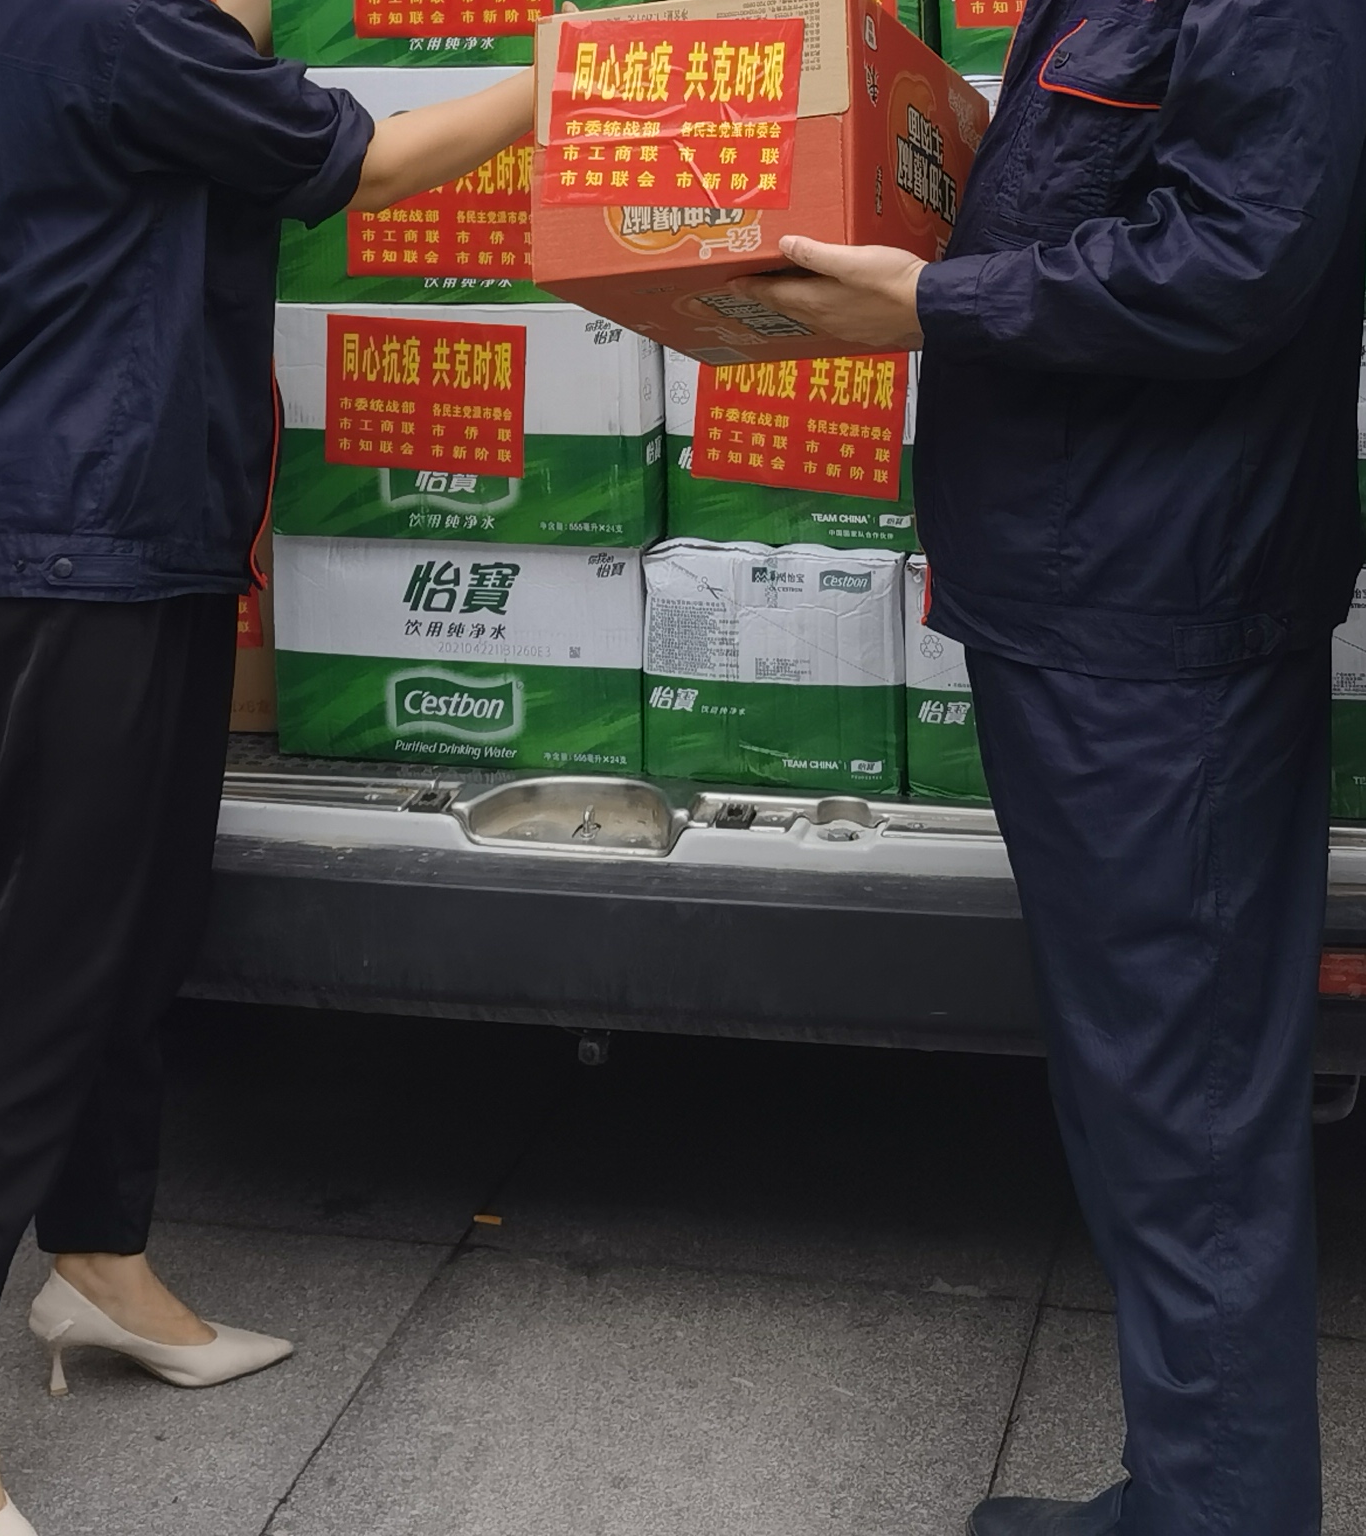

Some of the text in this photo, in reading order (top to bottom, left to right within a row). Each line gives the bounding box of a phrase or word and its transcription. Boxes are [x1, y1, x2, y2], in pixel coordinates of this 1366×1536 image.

[368, 9, 543, 25] 市知联会 市新阶联
[409, 37, 495, 51] 饮用纯净水
[571, 40, 786, 104] 同心抗疫 共克时艰
[565, 119, 781, 140] 市委统战部 各民主党派市委会
[562, 143, 779, 165] 市工商联 市侨联
[559, 170, 777, 190] 市知联会 市新阶联
[362, 208, 439, 222] 市委统战部
[362, 229, 439, 243] 市工商联
[701, 226, 761, 252] 统一
[362, 249, 438, 263] 市知联会
[343, 333, 511, 389] 同心抗疫 共克时艰
[809, 356, 895, 408] 共克时艰
[341, 398, 511, 420] 市委统战部 各民主党派市委会
[341, 418, 511, 441] 市工商联 市侨联
[711, 406, 890, 440] 市委统战部 各民主党派市委会
[340, 439, 511, 461] 市知联会 市新阶联
[709, 427, 889, 461] 市工商联 市侨联
[707, 448, 886, 482] 市知联会 市新阶联
[408, 512, 495, 530] 饮用纯净水
[811, 513, 868, 525] TEAM CHINA
[402, 560, 521, 615] 怡寶
[404, 619, 506, 640] 饮用纯净水
[404, 690, 505, 720] C'estbon
[649, 685, 699, 712] 怡寶
[918, 700, 979, 730] 怡寶
[395, 740, 517, 760] Purified Drinking Water
[782, 759, 839, 770] TEAM CHINA
